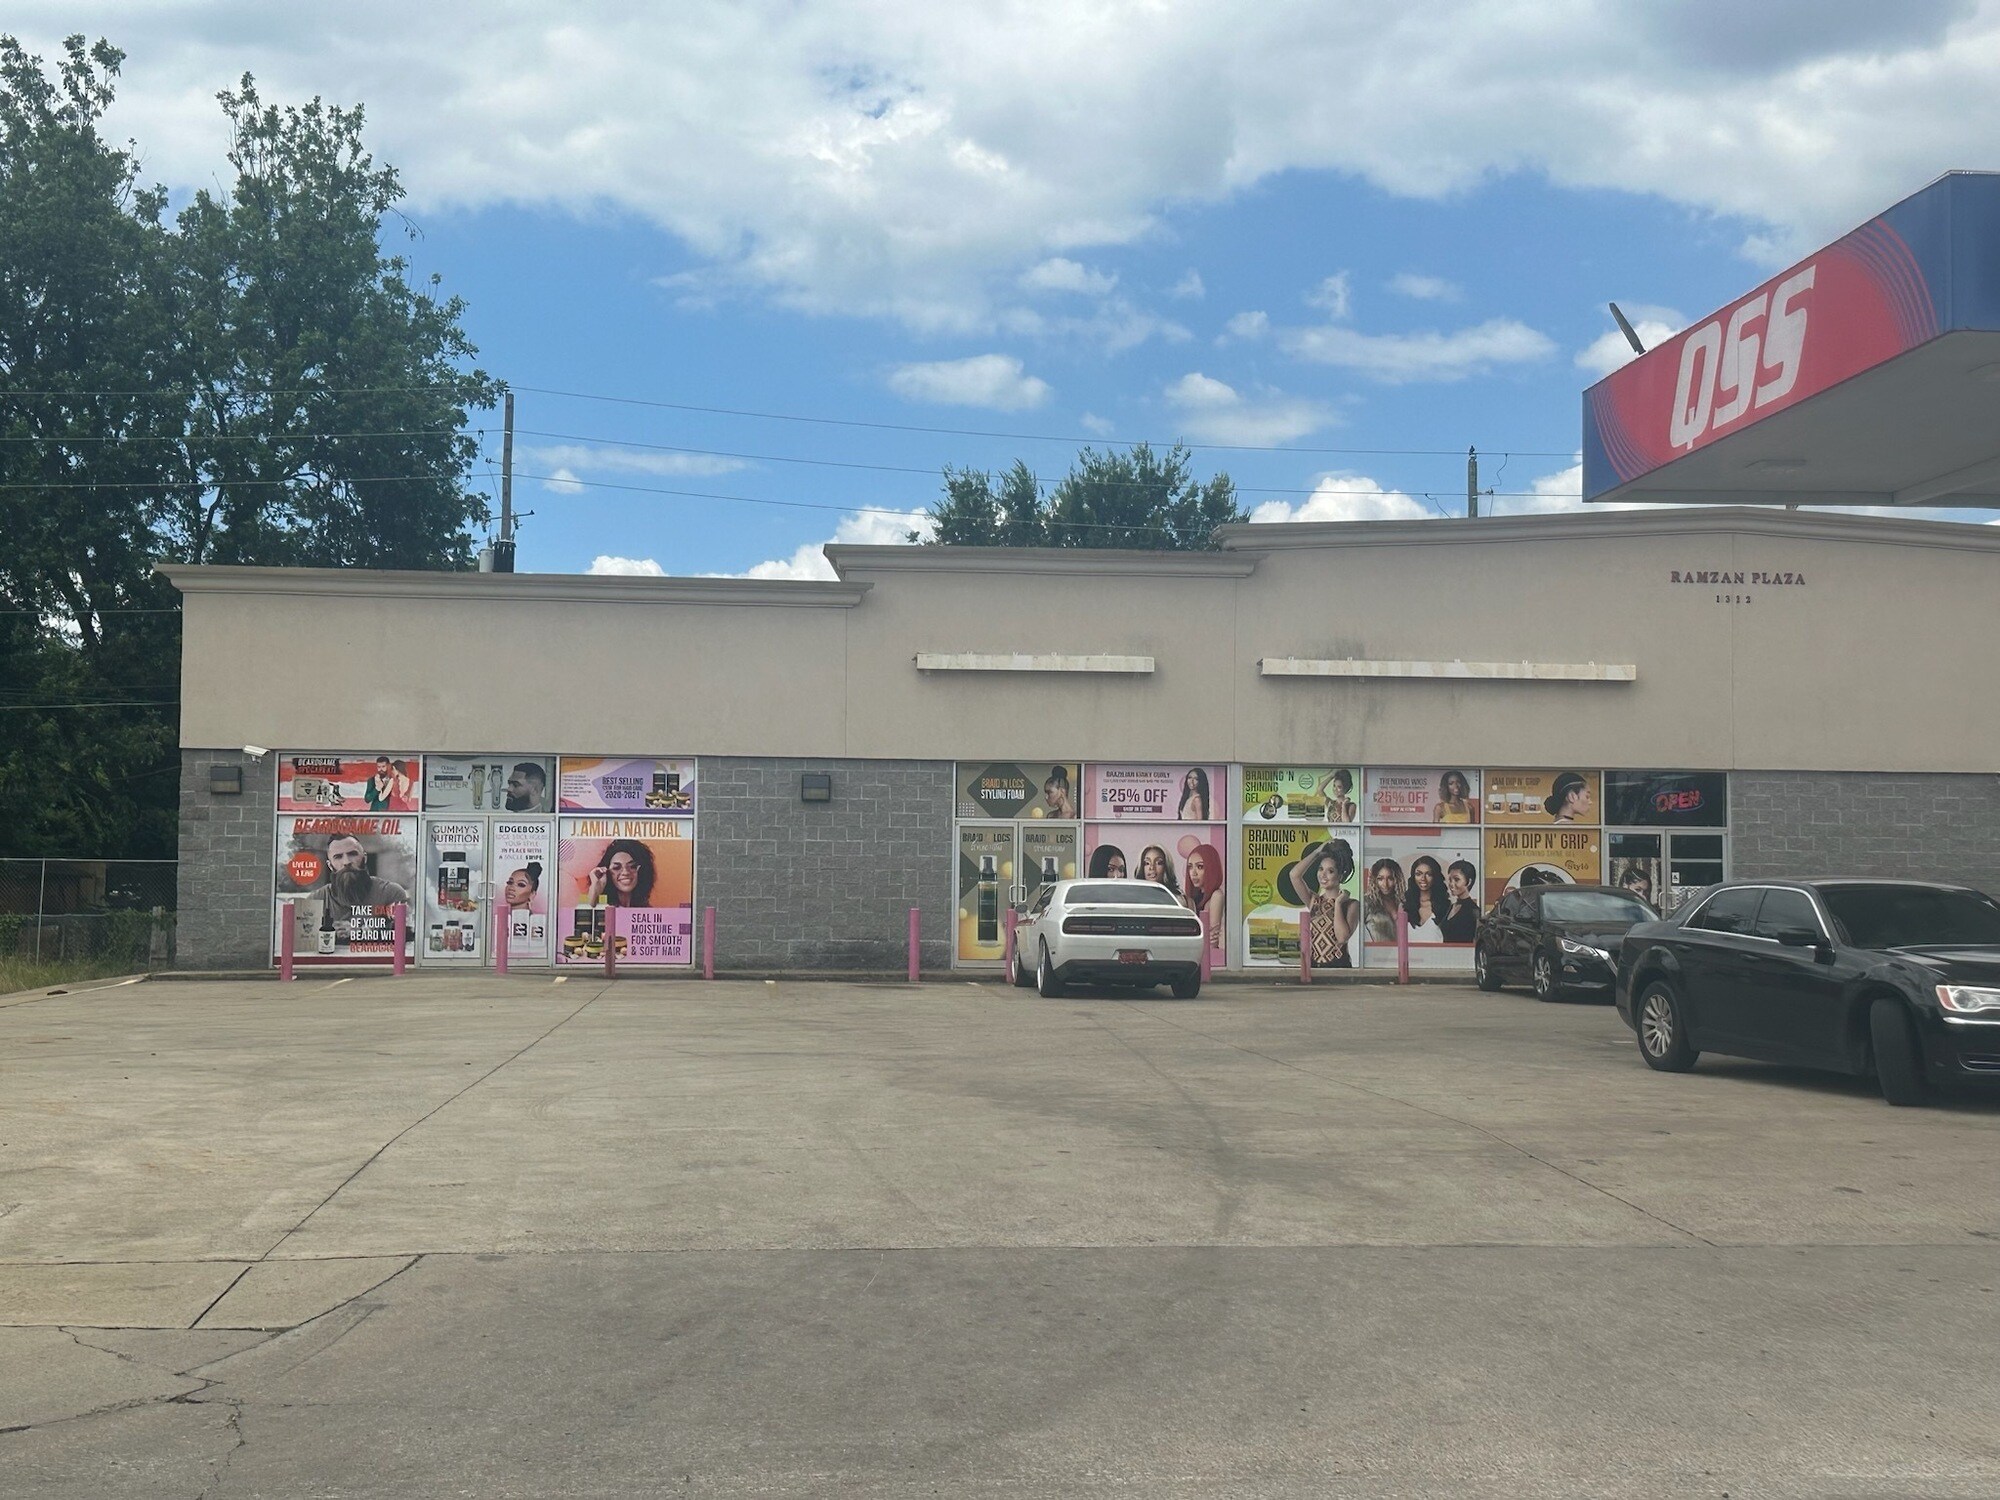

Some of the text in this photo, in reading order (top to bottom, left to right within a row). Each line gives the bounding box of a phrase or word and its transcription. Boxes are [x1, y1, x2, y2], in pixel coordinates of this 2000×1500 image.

[1670, 264, 1816, 450] QSS
[1670, 571, 1805, 585] RAMZAN PLAZA
[1245, 770, 1284, 781] BRAIDING
[1286, 770, 1294, 781] 'N
[428, 780, 469, 789] CLIPPER
[602, 777, 644, 786] BEST SELLING
[981, 778, 1000, 788] BRAID
[1008, 778, 1025, 789] LOCS
[1245, 781, 1279, 792] SHINING
[1379, 777, 1427, 786] TRENDING WIGS
[1491, 777, 1505, 786] JAM
[604, 791, 640, 799] 2020-2021
[980, 788, 1025, 800] STYLING FOAM
[1108, 788, 1168, 803] 25% OFF
[1245, 792, 1260, 803] GEL
[1377, 791, 1405, 804] 25%
[1408, 791, 1429, 804] OFF
[1656, 790, 1700, 812] OPEN
[381, 818, 402, 835] OIL
[432, 825, 479, 834] GUMMY'S
[499, 825, 546, 833] EDGEBOSS
[571, 820, 681, 838] J.AMILA NATURAL
[431, 834, 480, 843] NUTRITION
[962, 833, 984, 842] BRAID
[993, 833, 1011, 843] LOCS
[1025, 834, 1047, 843] BRAID
[1056, 834, 1073, 844] LOCS
[1248, 829, 1309, 843] BRAIDING 'N
[1494, 833, 1589, 850] JAM DIP N' GRIP
[1248, 843, 1289, 857] SHINING
[1248, 857, 1267, 870] GEL
[350, 905, 373, 915] TAKE
[350, 917, 386, 928] OF YOUR
[631, 913, 662, 923] SEAL IN
[631, 924, 672, 934] MOISTURE
[350, 930, 395, 941] BEARD WIT
[631, 935, 682, 945] FOR SMOOTH
[631, 946, 681, 956] & SOFT HAIR
